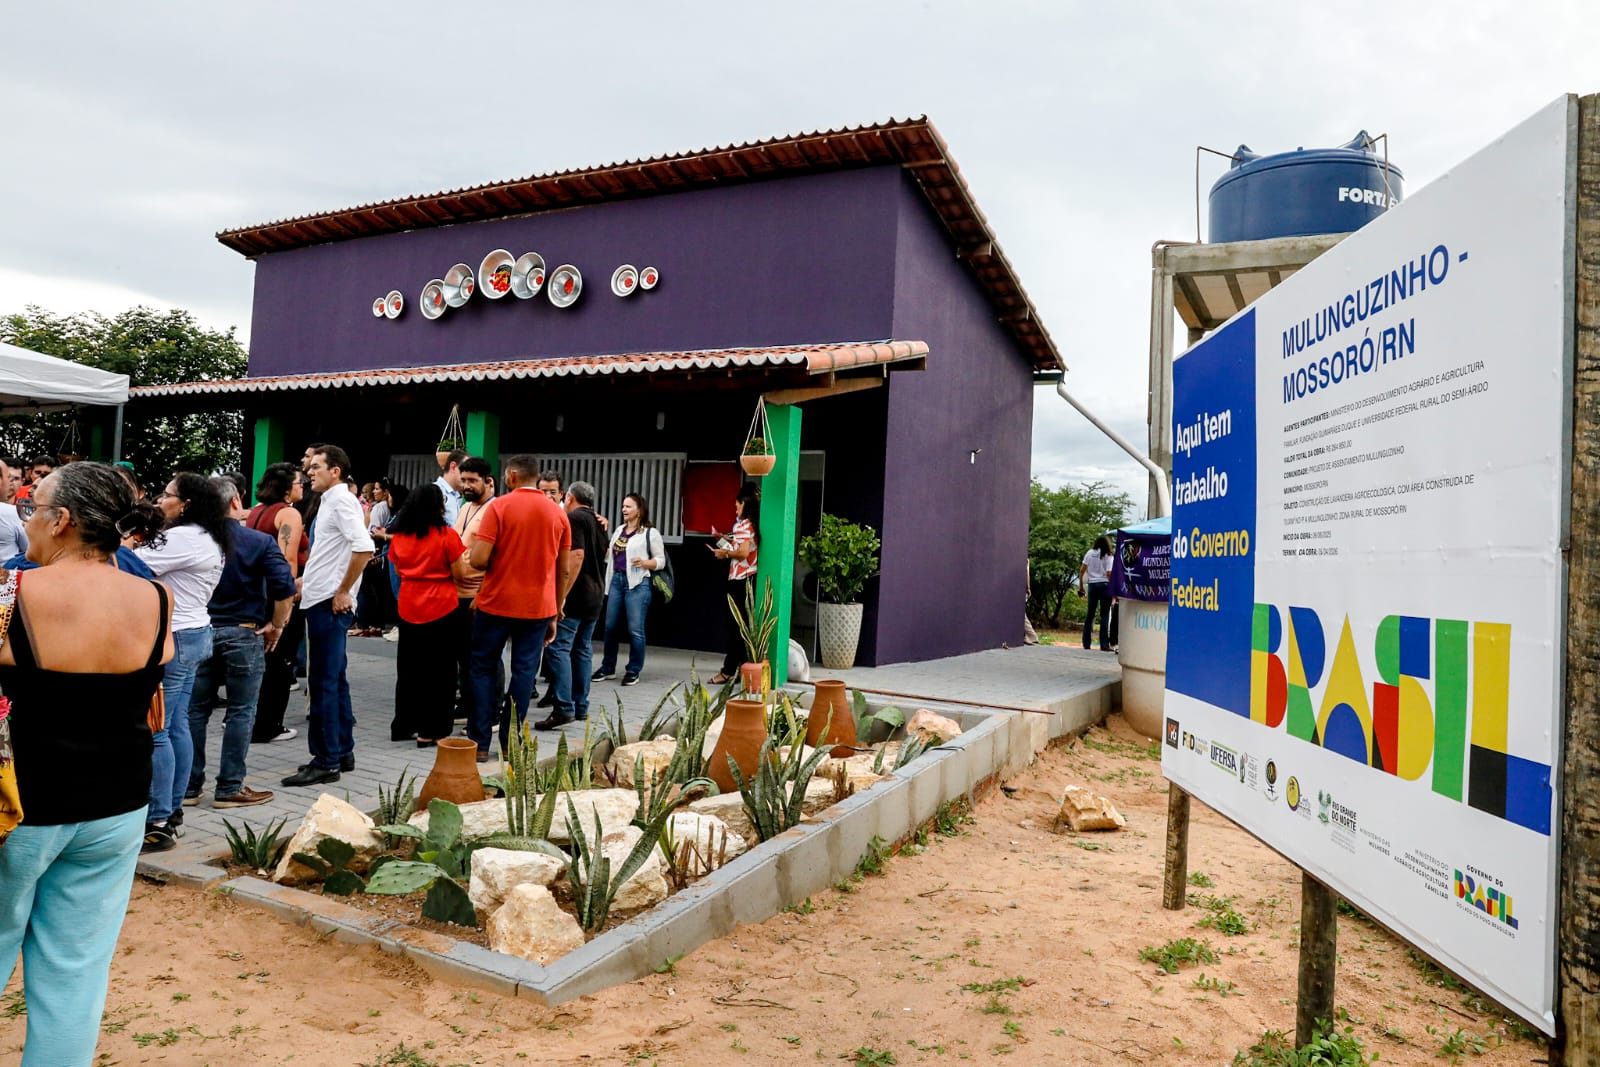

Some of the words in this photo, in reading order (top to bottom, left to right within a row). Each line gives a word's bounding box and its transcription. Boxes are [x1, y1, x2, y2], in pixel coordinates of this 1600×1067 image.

[1282, 244, 1449, 359] MULUNGUZINHO
[1283, 317, 1415, 404] MOSSORÓ/RN
[1362, 385, 1408, 408] DESENVOLVIMENTO
[1408, 376, 1435, 392] AGRÁRIO
[1441, 360, 1485, 382] AGRICULTURA
[1361, 408, 1395, 426] UNIVERSIDADE
[1395, 402, 1419, 416] FEDERAL
[1419, 396, 1440, 409] RURAL
[1440, 392, 1451, 404] DO
[1451, 381, 1489, 401] SEMI-ÁRIDO
[1175, 413, 1202, 458] Aqui
[1203, 409, 1231, 443] tem
[1175, 465, 1228, 506] trabalho
[1397, 484, 1410, 495] COM
[1410, 481, 1425, 492] ÁREA
[1464, 474, 1475, 485] DE
[1350, 509, 1364, 519] RURAL
[1365, 507, 1373, 517] DE
[1172, 528, 1188, 559] do
[1190, 527, 1249, 558] Governo
[1171, 577, 1219, 612] Federal
[1250, 602, 1552, 836] BRASIL
[1210, 744, 1237, 772] UFERSA
[1332, 810, 1339, 821] DO
[1340, 814, 1357, 831] NORTE
[1340, 804, 1357, 820] GRANDE
[1466, 864, 1493, 882] GOVERNO
[1495, 878, 1504, 887] DO
[1454, 868, 1519, 931] BRASIL
